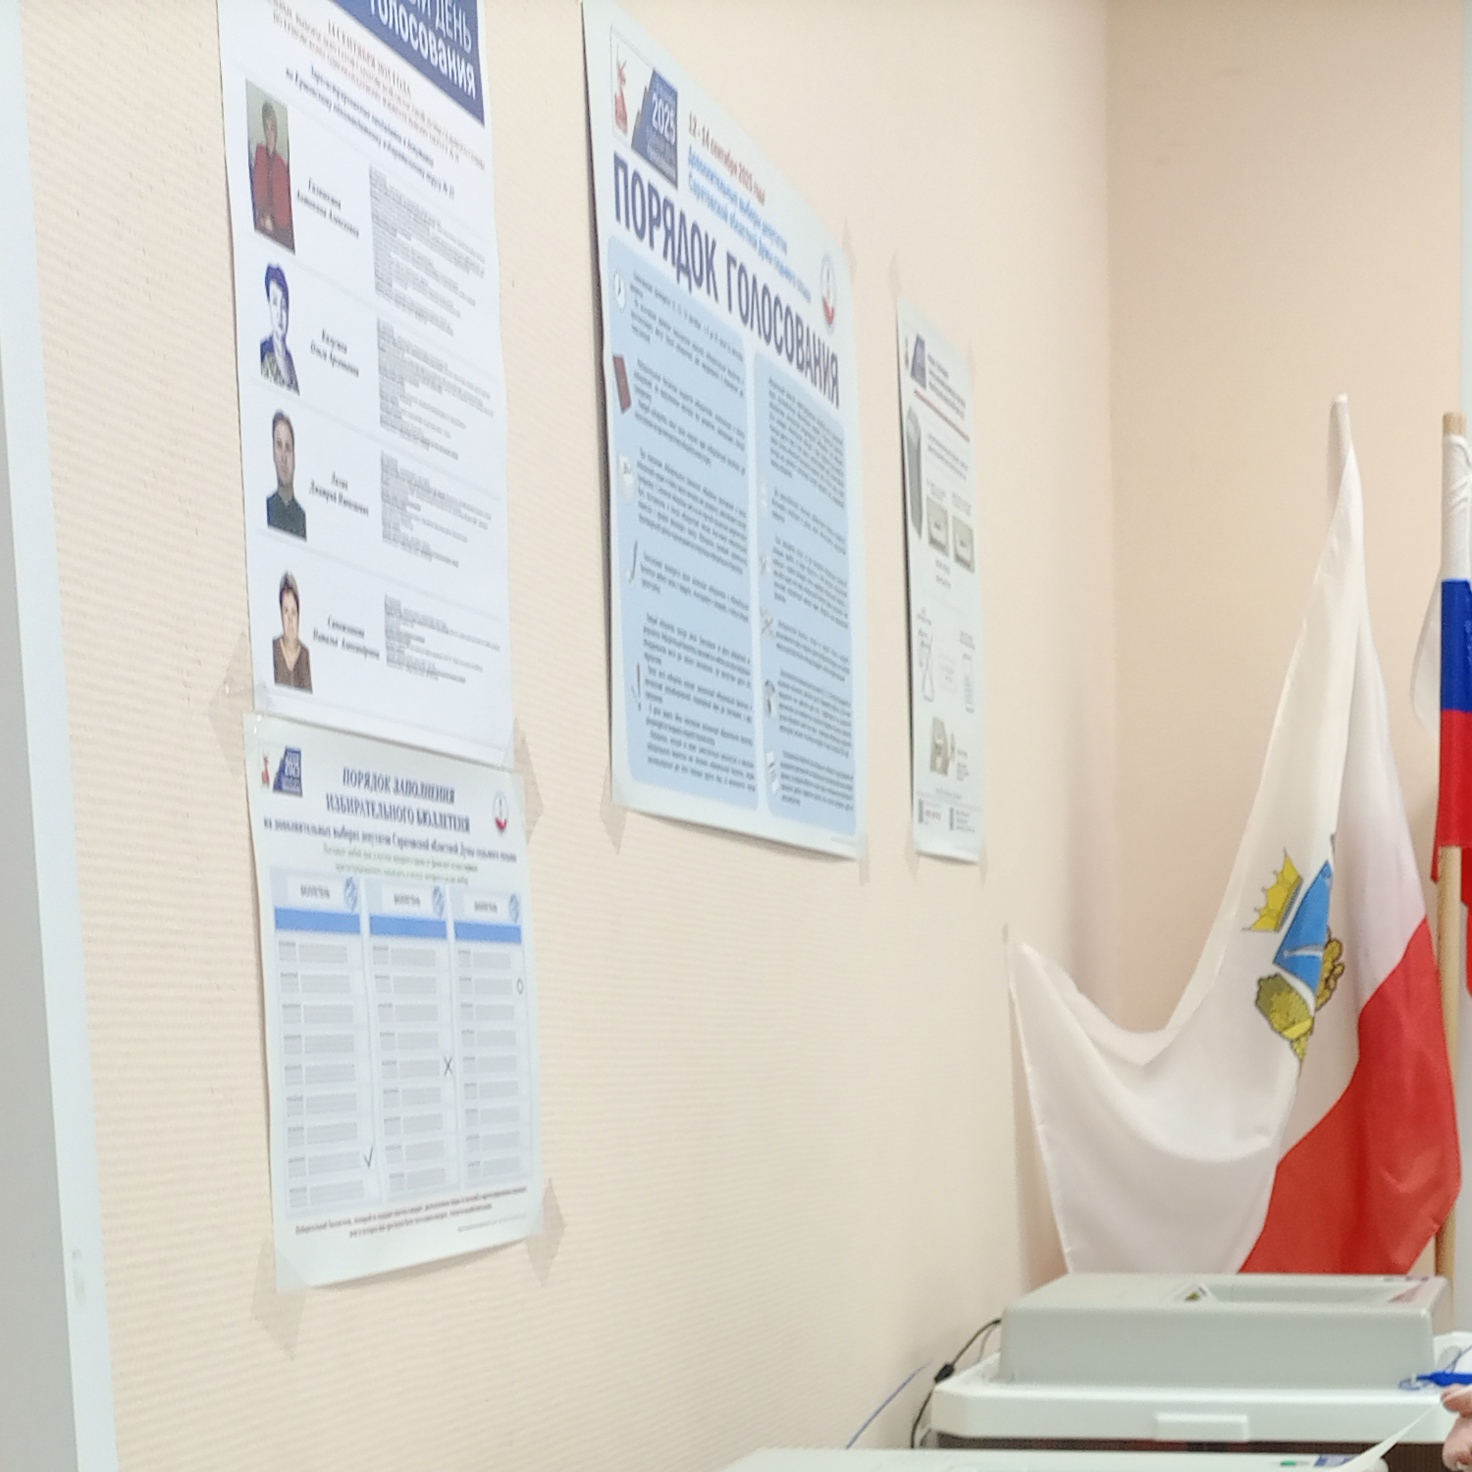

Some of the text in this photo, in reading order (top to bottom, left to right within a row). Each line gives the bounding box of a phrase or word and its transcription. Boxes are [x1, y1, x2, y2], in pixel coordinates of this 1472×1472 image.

[652, 93, 676, 145] 2025
[613, 150, 719, 303] ПОРЯДОК
[726, 250, 840, 410] ГОЛОСОВАНИЯ
[343, 766, 455, 805] ПОРЯДОК ЗАПОЛНЕНИЯ
[326, 792, 414, 826] ИЗБИРАТЕЛЬНОГО
